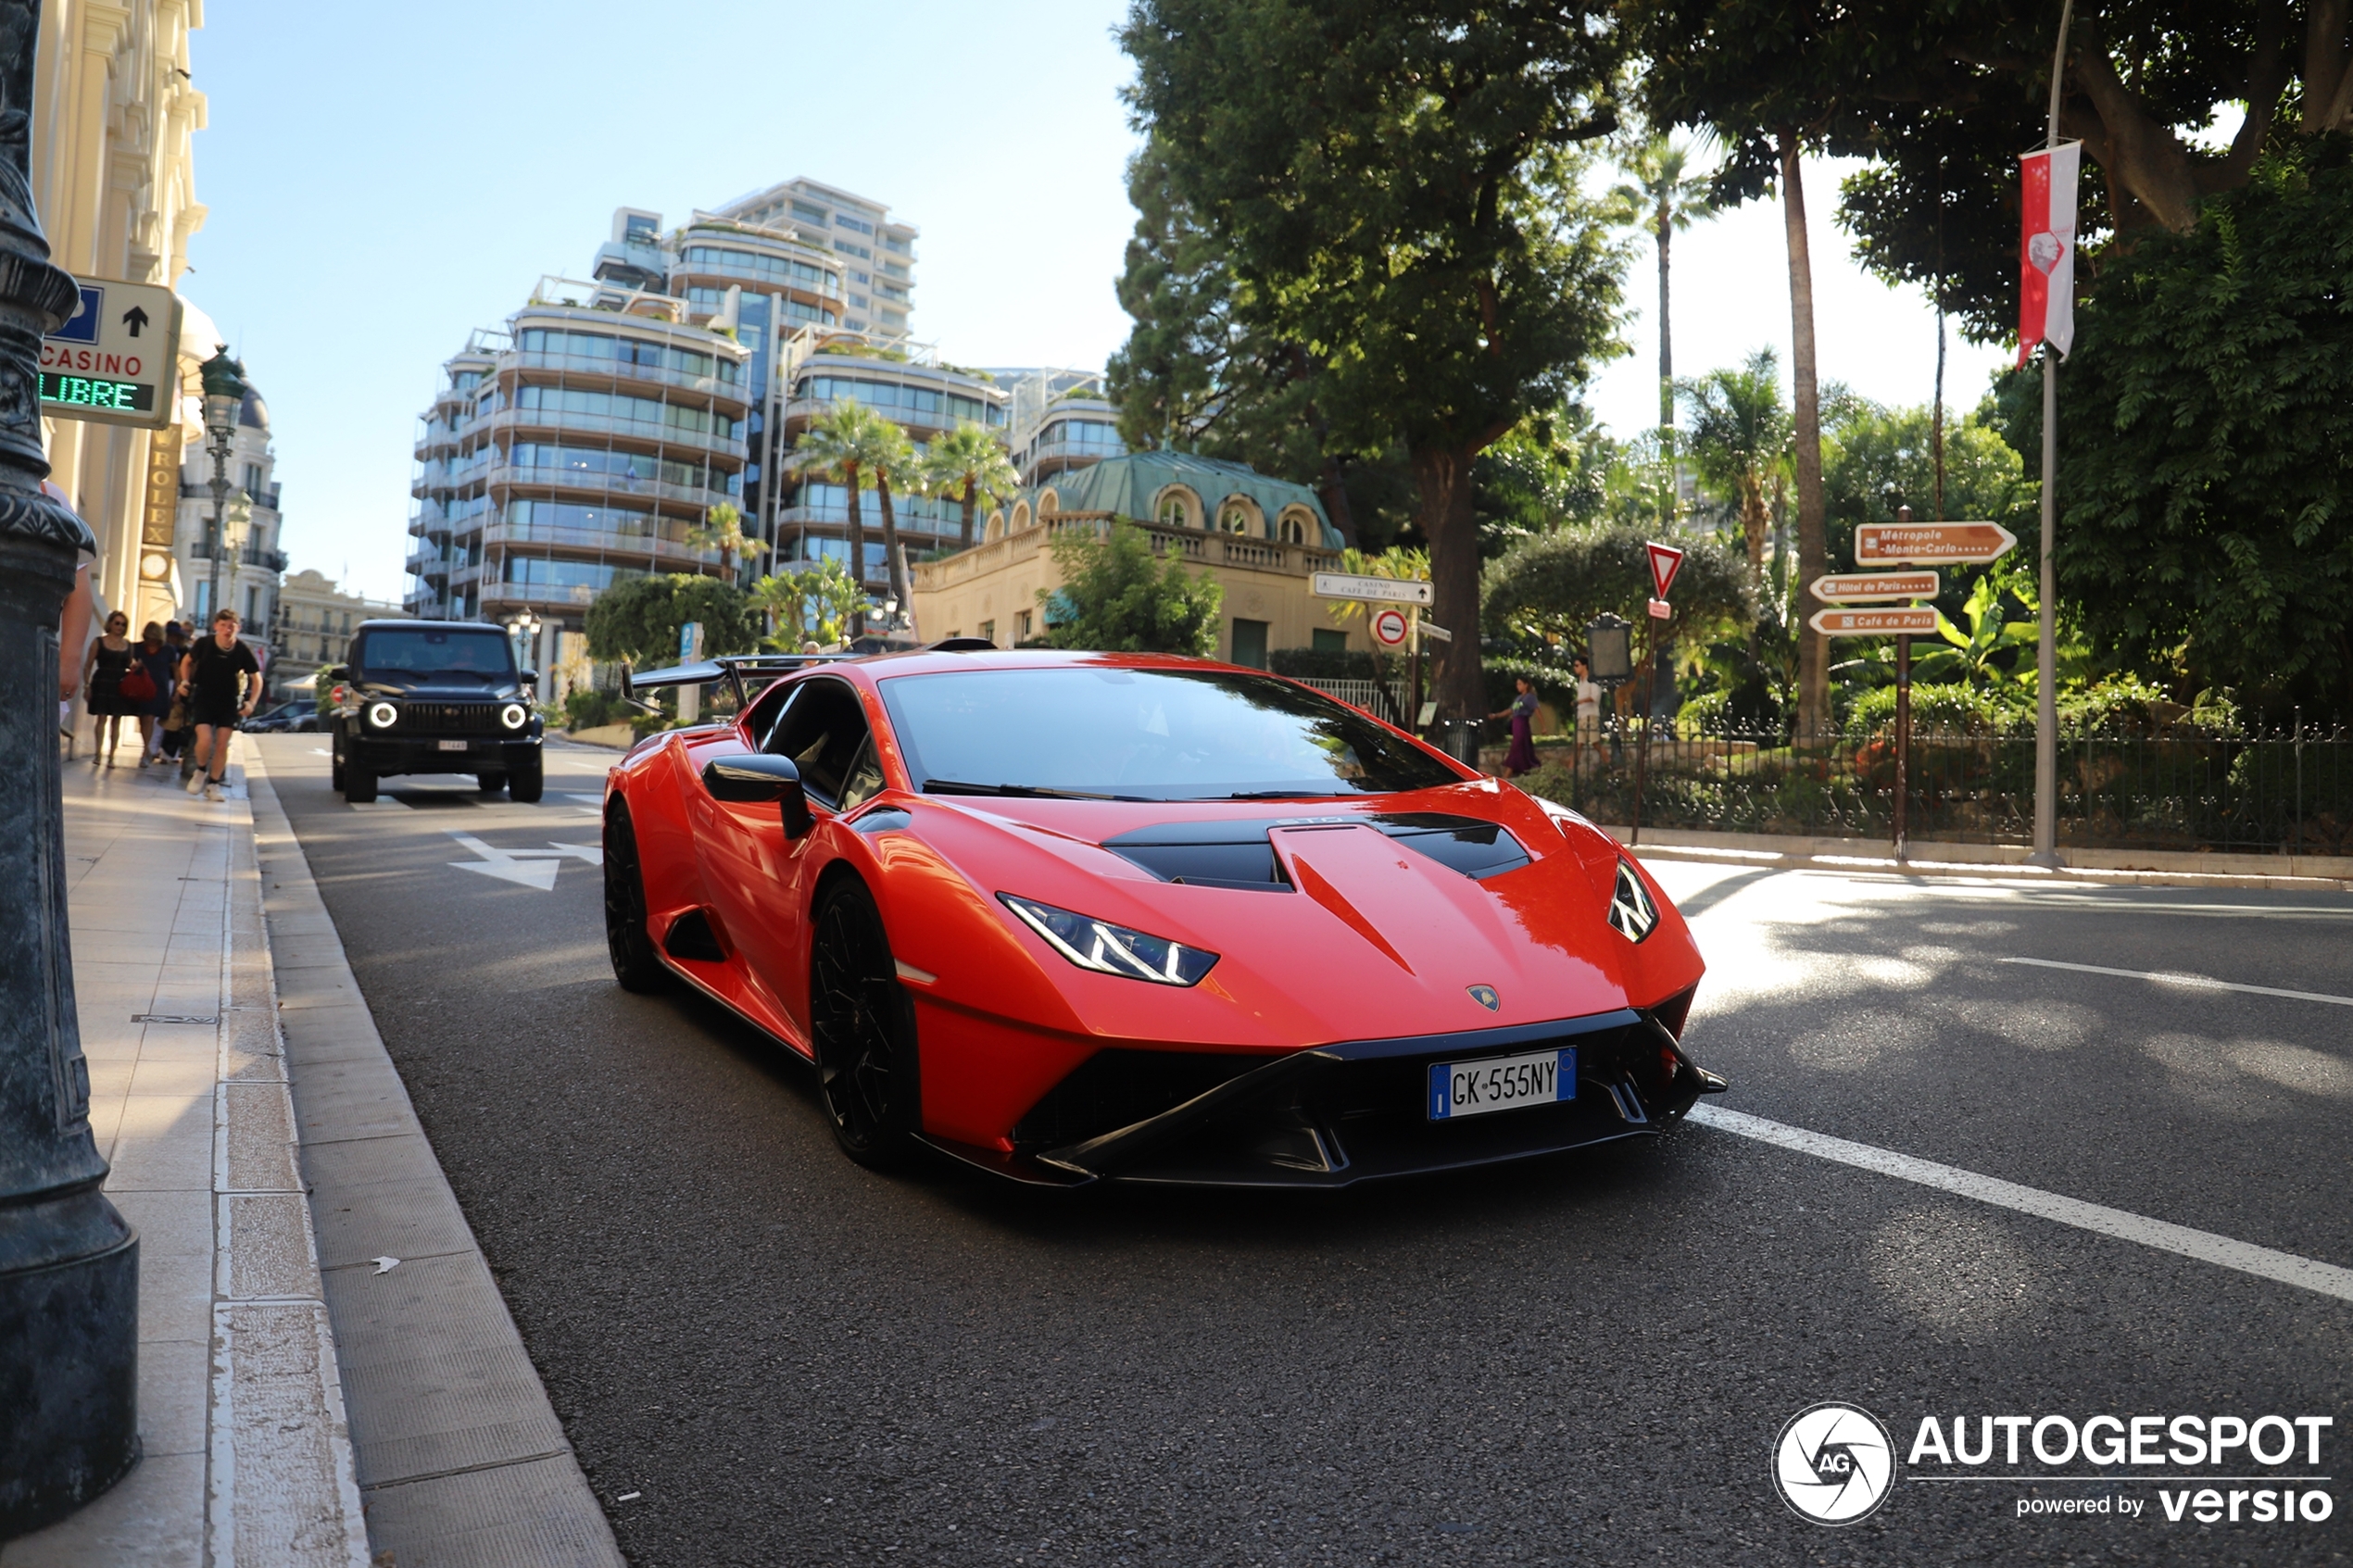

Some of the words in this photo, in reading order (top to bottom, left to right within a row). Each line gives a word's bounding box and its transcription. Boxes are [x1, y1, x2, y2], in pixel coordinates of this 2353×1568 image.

[40, 345, 142, 376] CASINO
[39, 373, 138, 411] LIBRE
[146, 451, 170, 543] ROLEX
[1880, 529, 1942, 543] Métropole
[1358, 580, 1390, 589] CASINO
[1837, 583, 1861, 592] Hôtel
[1864, 583, 1876, 591] de
[1877, 582, 1901, 591] Paris
[1382, 590, 1407, 598] PARIS
[1857, 615, 1882, 626] Café
[1886, 615, 1899, 625] de
[1903, 615, 1932, 625] Paris
